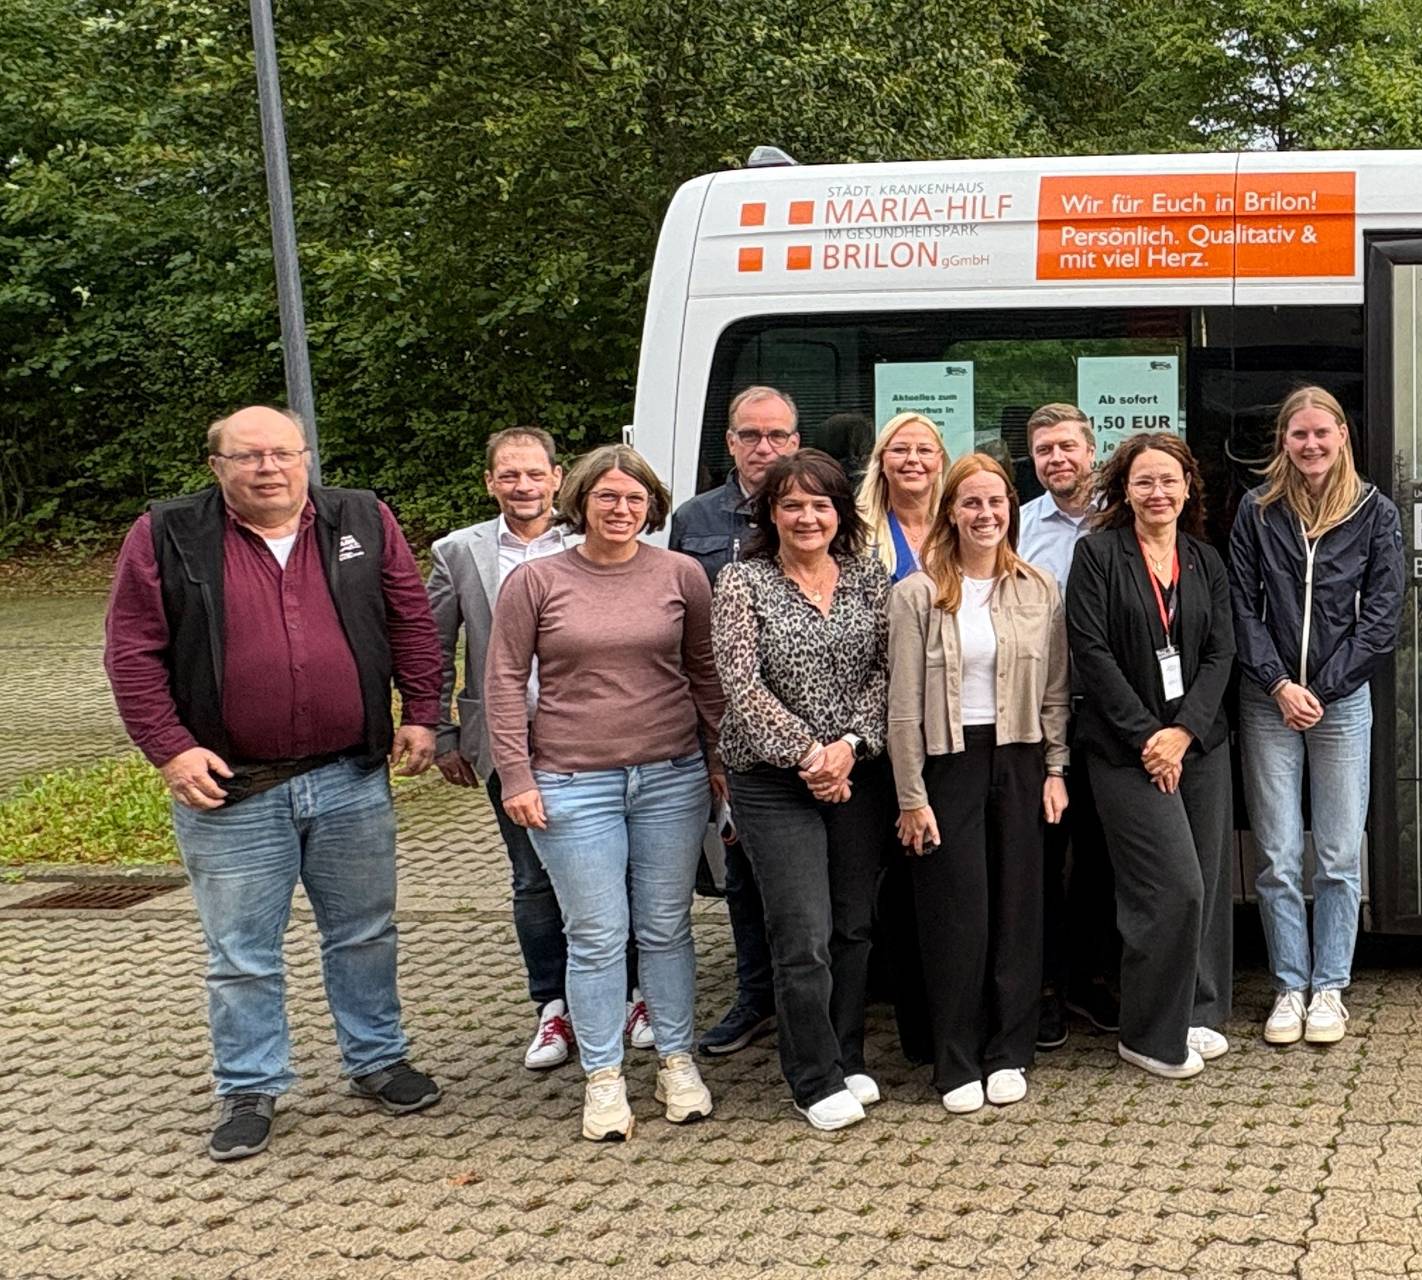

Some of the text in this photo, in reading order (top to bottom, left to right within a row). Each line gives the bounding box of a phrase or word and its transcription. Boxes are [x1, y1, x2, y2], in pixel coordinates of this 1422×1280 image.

[879, 182, 985, 195] KRANKENHAUS
[825, 194, 1013, 224] MARIA-HILF
[1060, 191, 1318, 214] Wir für Euch in Brilon!
[824, 224, 979, 240] IM GESUNDHEITSPARK
[1060, 223, 1318, 247] Persönlich. Qualitativ &
[823, 241, 990, 270] BRILON gGmbH
[1060, 247, 1209, 269] mit viel Herz.
[1098, 393, 1159, 405] Ab sofort
[1088, 415, 1171, 433] 1,50 EUR
[1103, 440, 1116, 454] je
